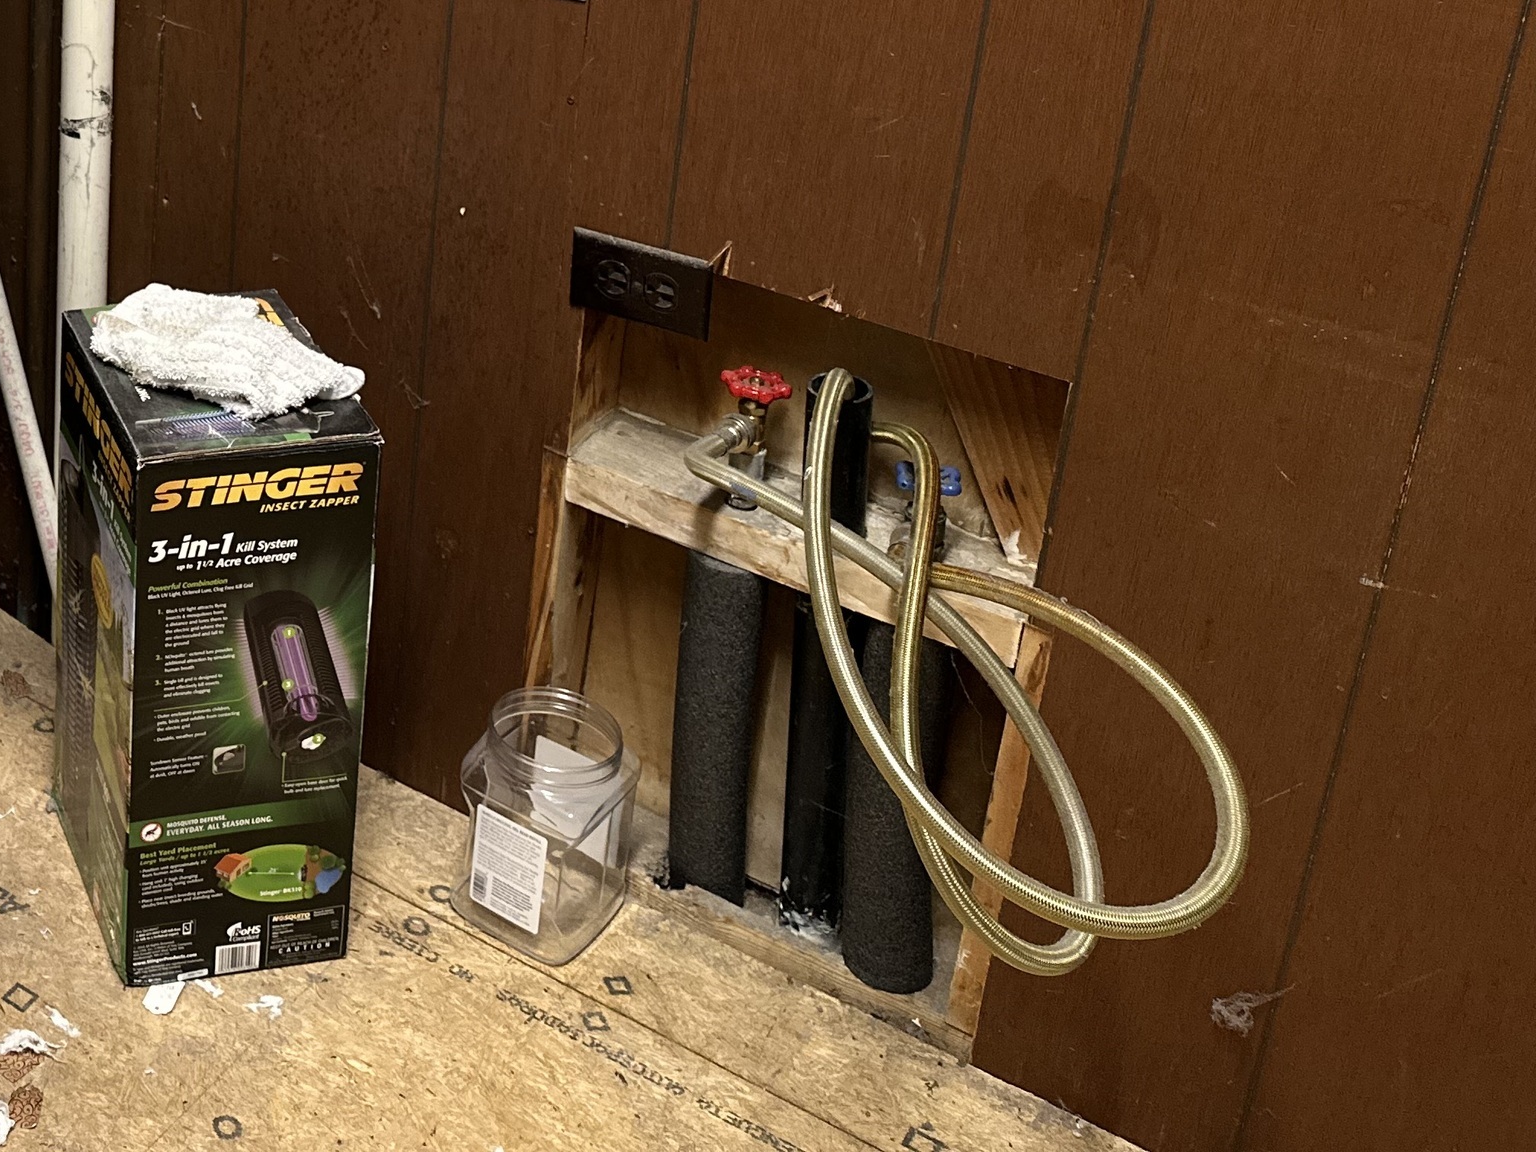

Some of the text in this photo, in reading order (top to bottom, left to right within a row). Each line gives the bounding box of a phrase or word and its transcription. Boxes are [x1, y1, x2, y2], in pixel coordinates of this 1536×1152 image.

[150, 462, 364, 512] STINGER
[260, 495, 360, 513] INSECT ZAPPER
[148, 532, 298, 563] 3-in-1 Kill System
[176, 563, 185, 572] up
[215, 556, 241, 569] Acre
[244, 551, 297, 566] Coverage
[147, 577, 228, 593] Powerful Combination
[166, 814, 227, 828] MOSQUITO DEFENSE.
[166, 815, 273, 837] EVERYDAY. ALL SEASON LONG.
[140, 842, 216, 859] Best Yard Placement
[272, 912, 311, 922] MOSQUITO
[235, 925, 261, 936] RoHS
[278, 942, 330, 954] CAUTION
